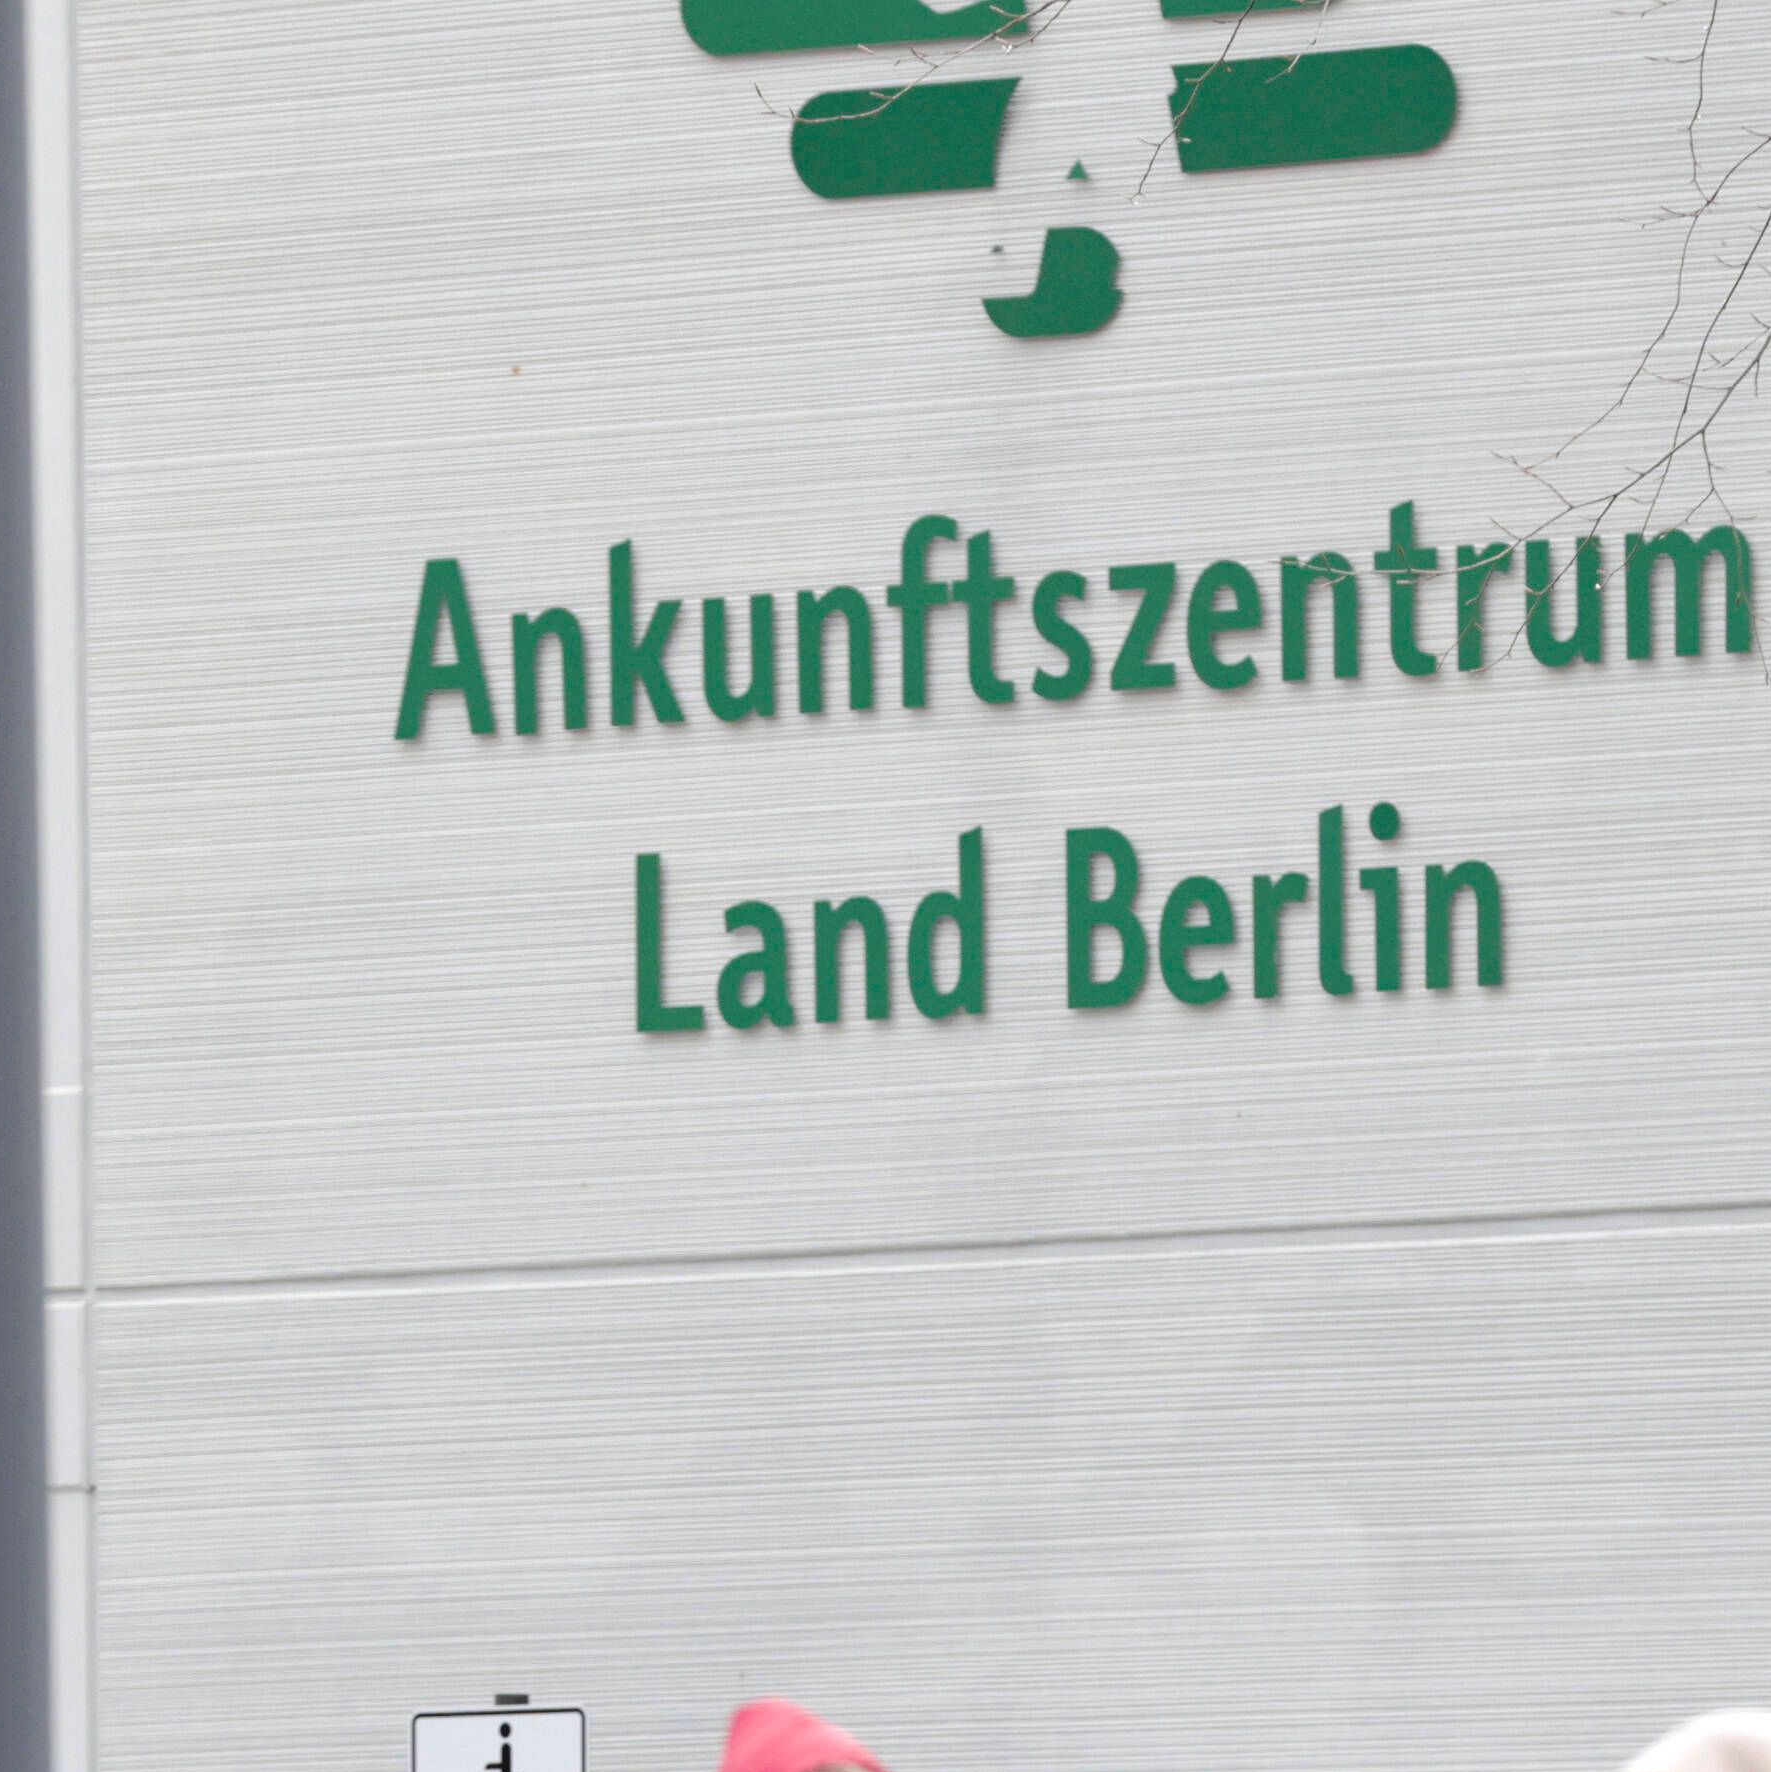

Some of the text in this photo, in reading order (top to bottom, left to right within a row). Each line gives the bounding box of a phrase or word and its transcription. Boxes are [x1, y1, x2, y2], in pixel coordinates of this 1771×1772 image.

[395, 501, 1753, 741] Ankunftszentrum
[636, 802, 1503, 1033] Land Berlin
